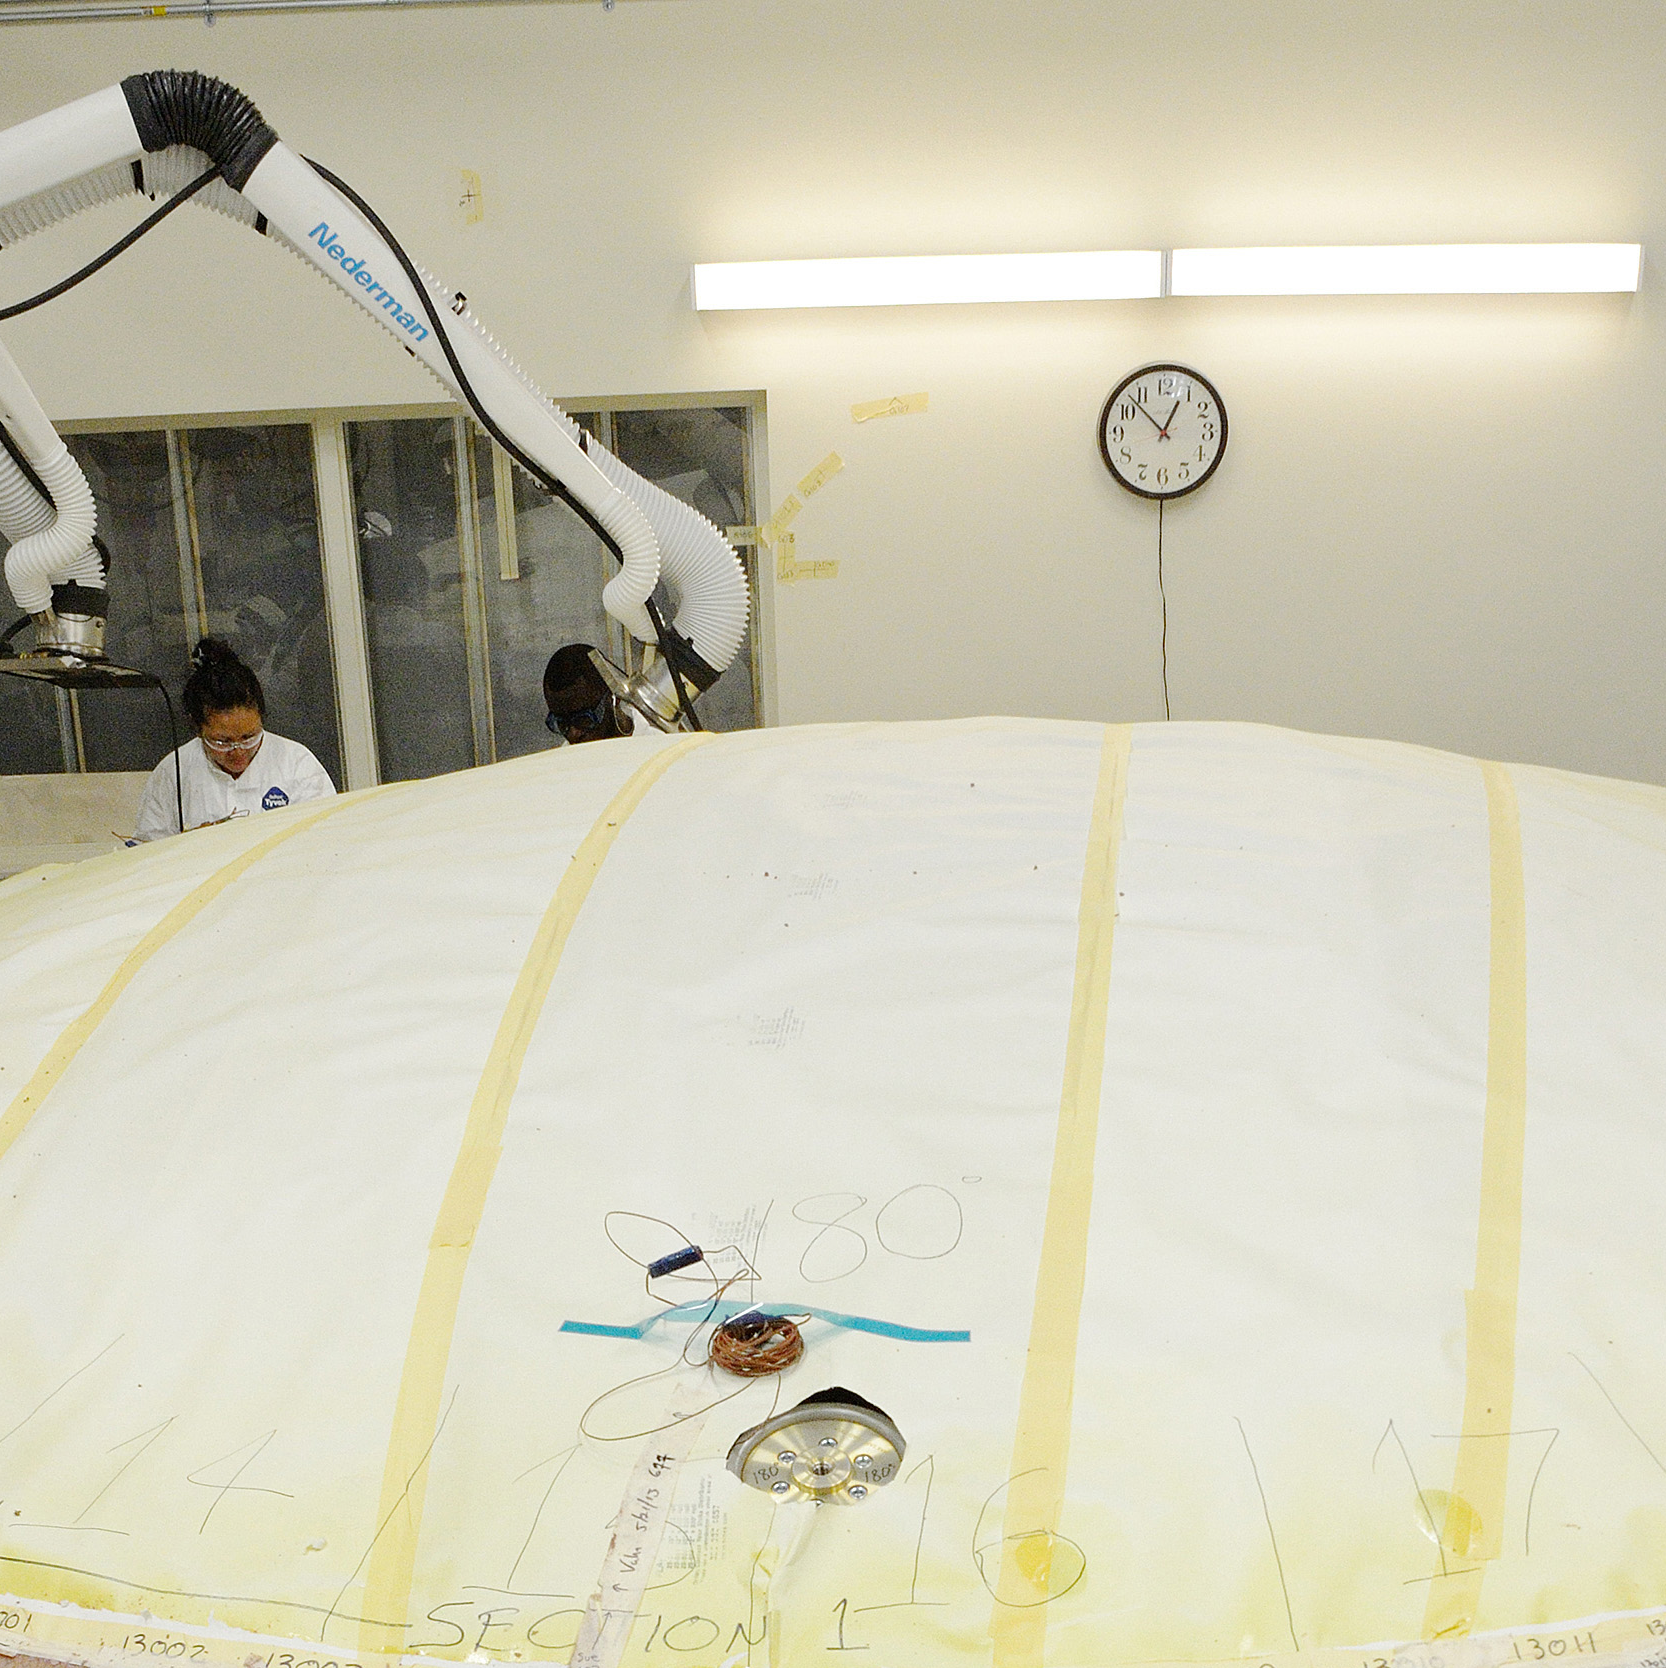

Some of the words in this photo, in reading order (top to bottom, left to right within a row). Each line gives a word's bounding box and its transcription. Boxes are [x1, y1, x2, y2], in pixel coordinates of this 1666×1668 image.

[308, 222, 429, 342] Nederman
[1137, 386, 1148, 404] 11
[1158, 377, 1174, 396] 12
[1120, 403, 1136, 421] 10
[1197, 402, 1209, 419] 2
[1112, 425, 1124, 443] 9
[1202, 422, 1214, 441] 3
[1120, 446, 1132, 464] 8
[1193, 445, 1206, 462] 4
[1137, 463, 1148, 481] 7
[1157, 467, 1169, 486] 6
[1178, 462, 1190, 479] 5
[8, 1413, 295, 1536] 14
[752, 1461, 780, 1485] 180°
[863, 1462, 896, 1484] 180°
[1372, 1418, 1561, 1585] 17
[853, 1454, 1087, 1608] 16
[408, 1600, 768, 1653] SECION
[826, 1598, 871, 1651] 1
[122, 1633, 209, 1660] 13002
[1511, 1631, 1597, 1661] 13011
